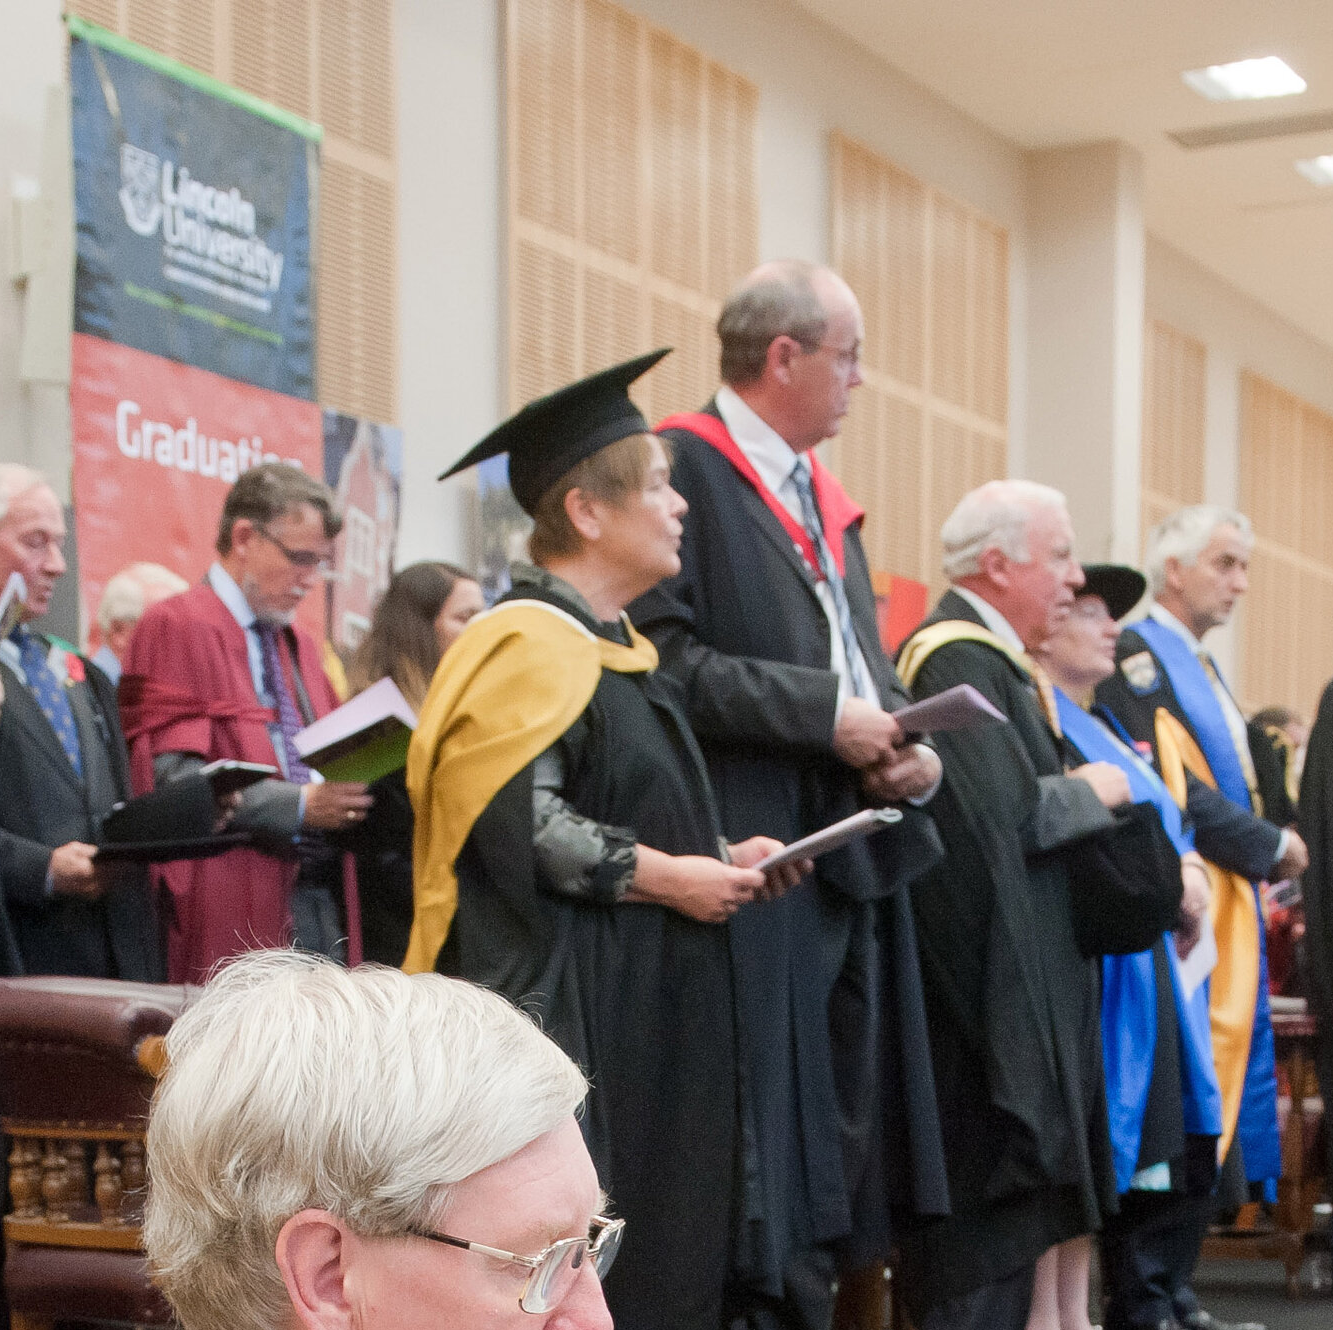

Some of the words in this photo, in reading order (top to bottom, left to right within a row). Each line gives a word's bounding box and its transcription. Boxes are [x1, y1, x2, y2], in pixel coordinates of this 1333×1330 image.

[163, 161, 255, 236] Lincoln
[163, 204, 283, 292] University
[116, 399, 303, 484] Graduati
